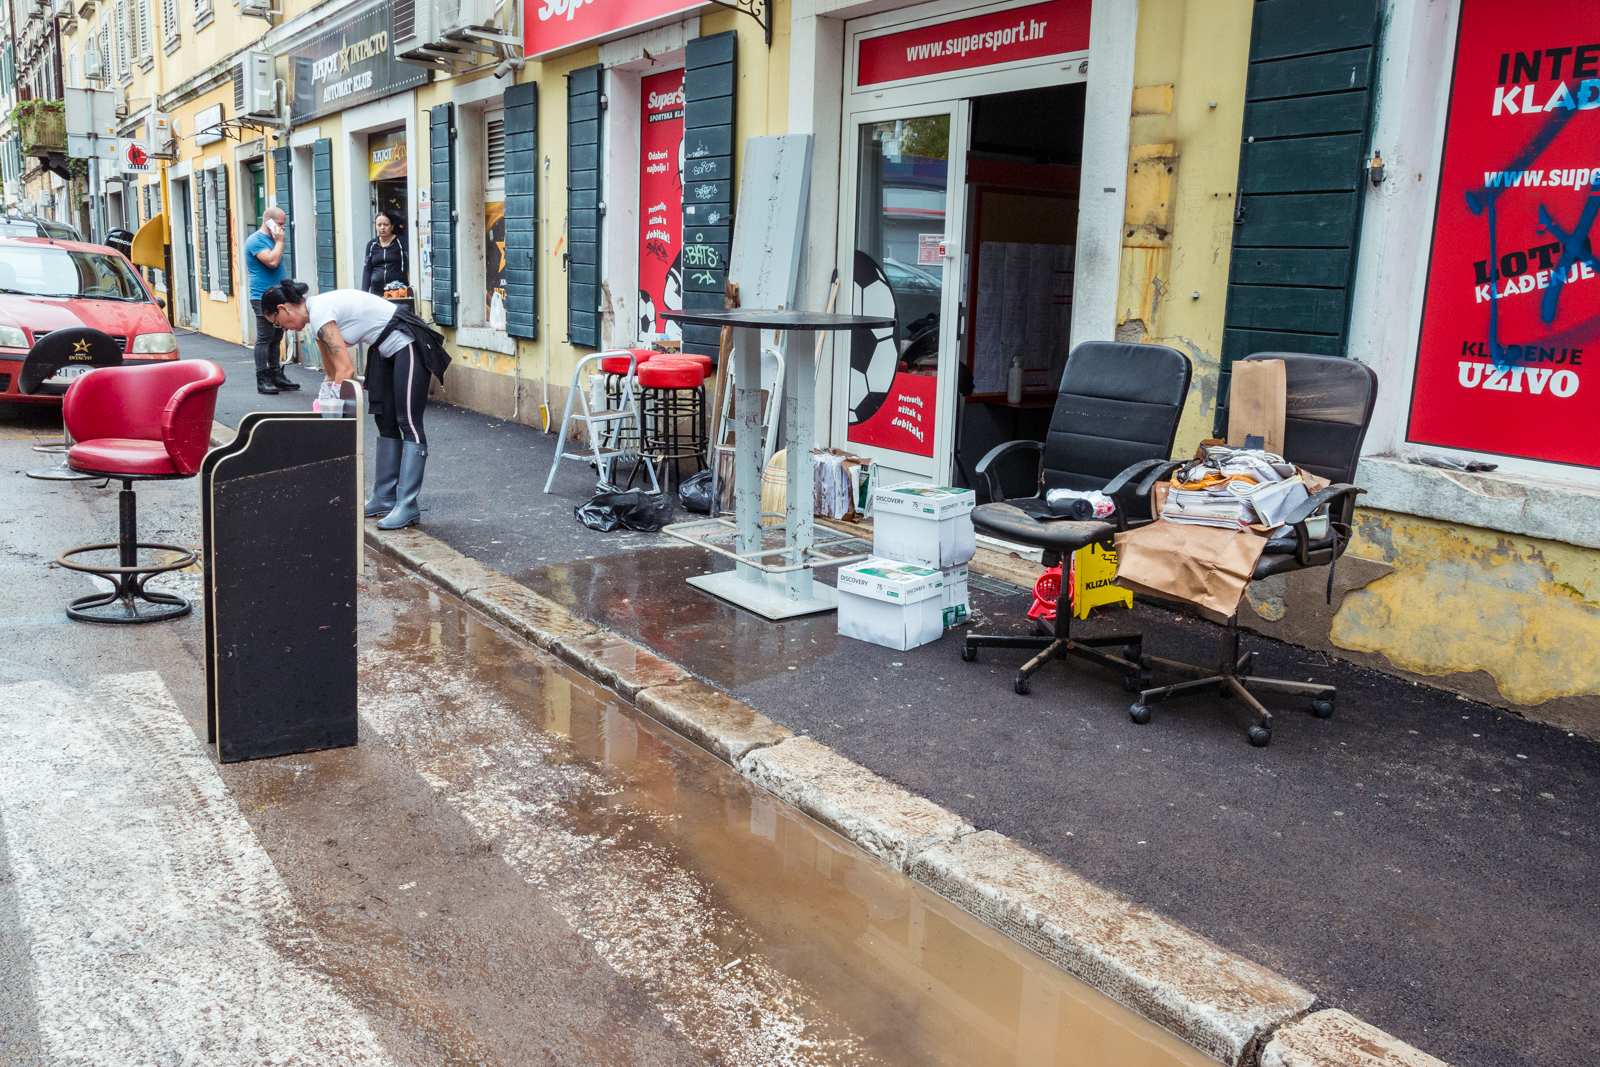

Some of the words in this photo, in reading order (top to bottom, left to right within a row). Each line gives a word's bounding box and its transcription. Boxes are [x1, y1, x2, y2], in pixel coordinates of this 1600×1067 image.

[349, 31, 387, 65] INTACTO
[906, 19, 1048, 62] www.supersport.hr
[1497, 43, 1600, 85] INTE
[323, 77, 353, 103] AUTOMAT
[353, 70, 373, 92] KLUB
[648, 85, 685, 111] SuperS
[649, 111, 673, 123] SPORTSKA
[646, 163, 666, 174] najbolju
[648, 150, 668, 161] Odaberi
[646, 230, 671, 244] dobitak!
[1475, 259, 1595, 303] KLAĐENJE
[891, 416, 924, 443] dobitak!
[876, 495, 904, 505] DISCOVERY
[840, 574, 868, 586] DISCOVERY
[876, 583, 883, 591] 75
